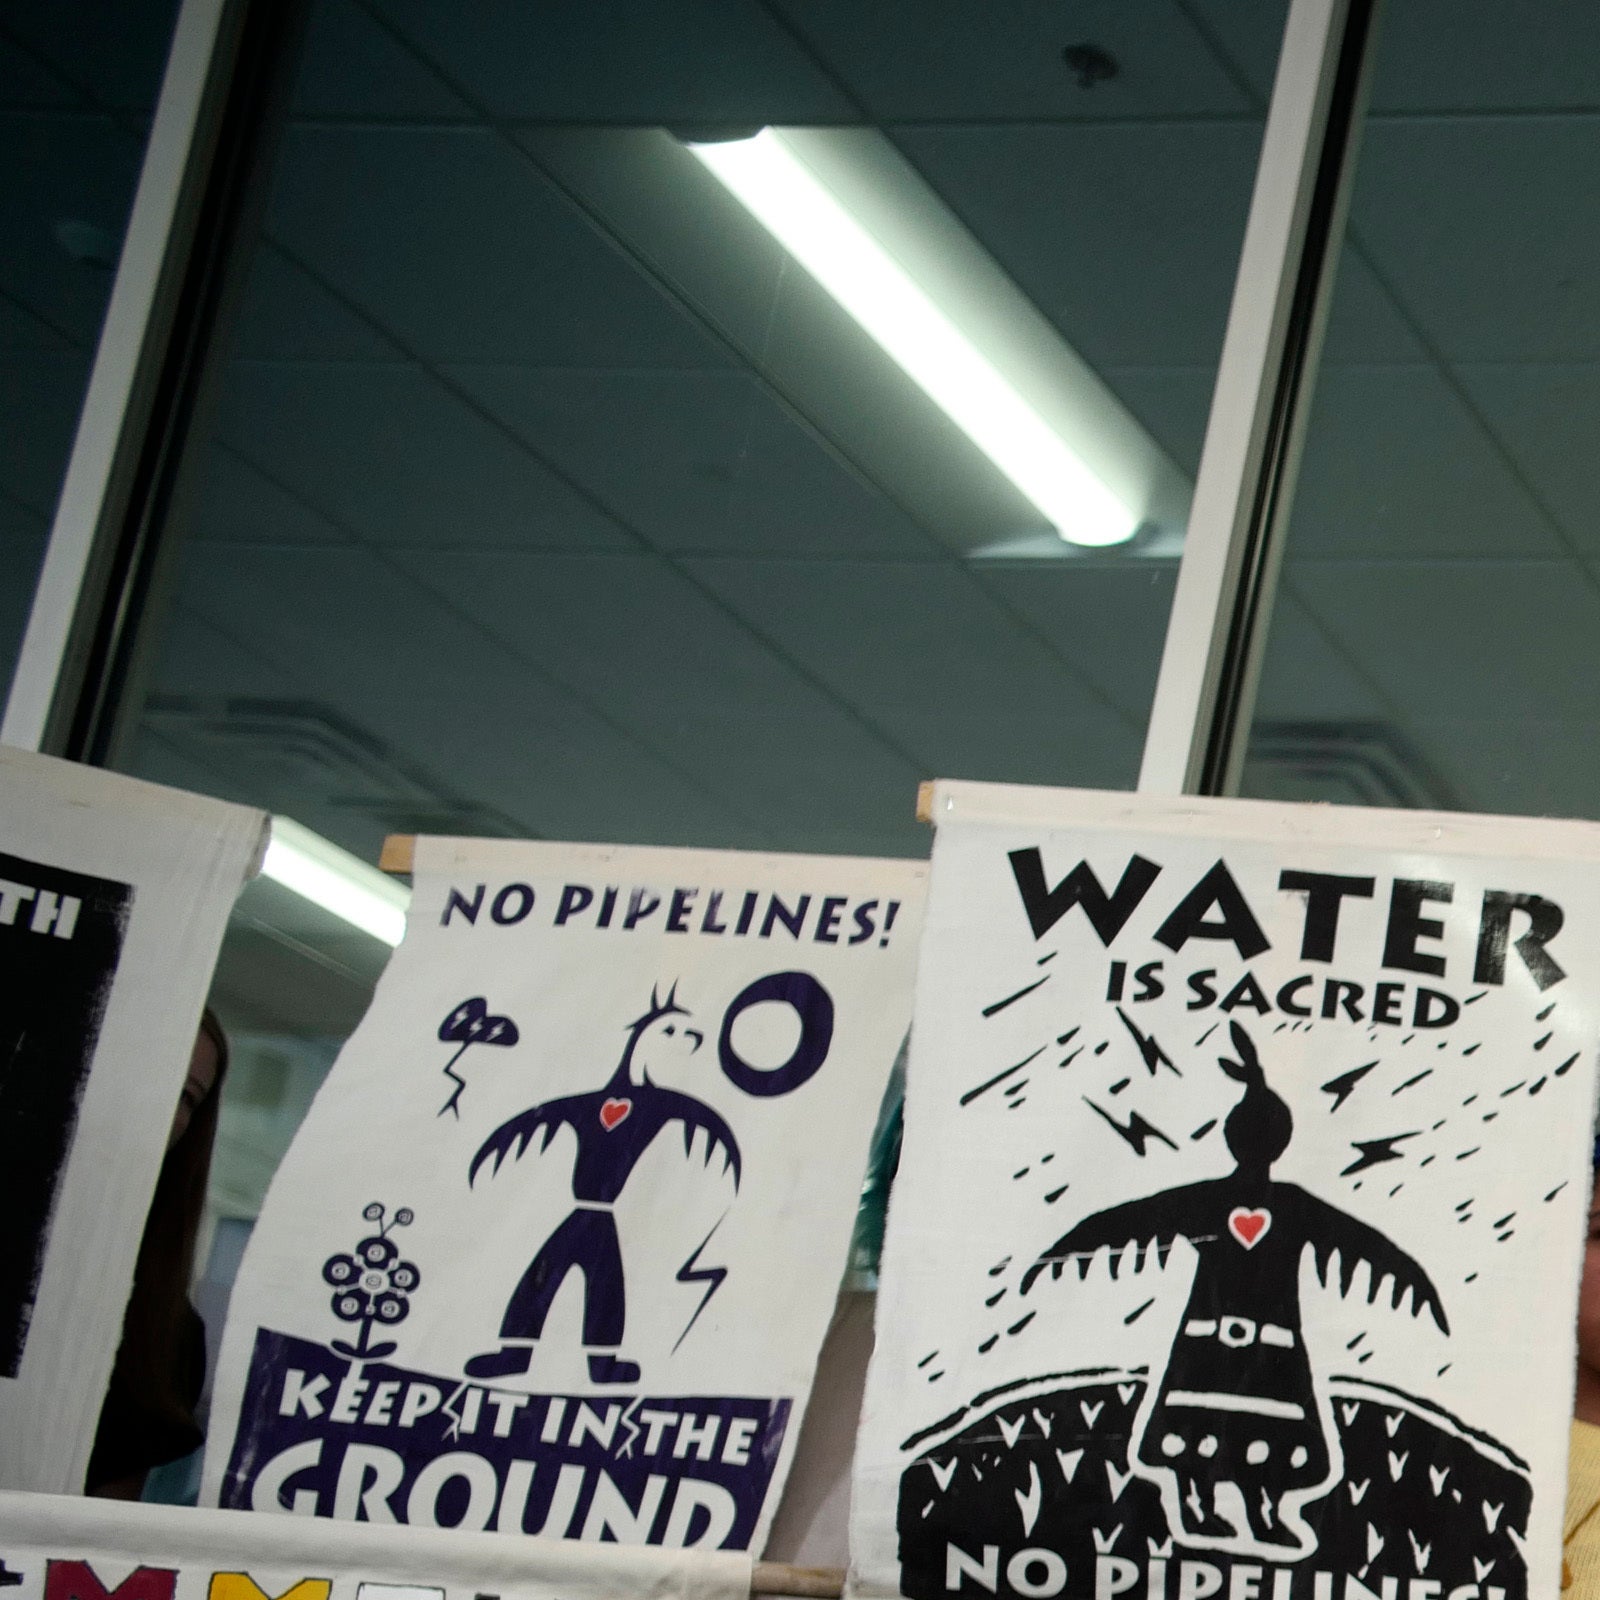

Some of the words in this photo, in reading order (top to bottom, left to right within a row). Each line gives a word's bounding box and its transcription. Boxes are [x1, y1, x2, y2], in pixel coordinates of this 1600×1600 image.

[439, 882, 536, 928] NO
[552, 883, 902, 950] PIPELINES!
[1006, 846, 1572, 995] WATER
[1106, 959, 1166, 1005] IS
[1185, 969, 1464, 1030] SACRED
[278, 1367, 443, 1428] KEEP
[458, 1386, 529, 1438] IT
[540, 1396, 624, 1452] IN
[639, 1408, 760, 1466] THE
[251, 1436, 738, 1550] GROUND
[944, 1543, 1069, 1600] NO
